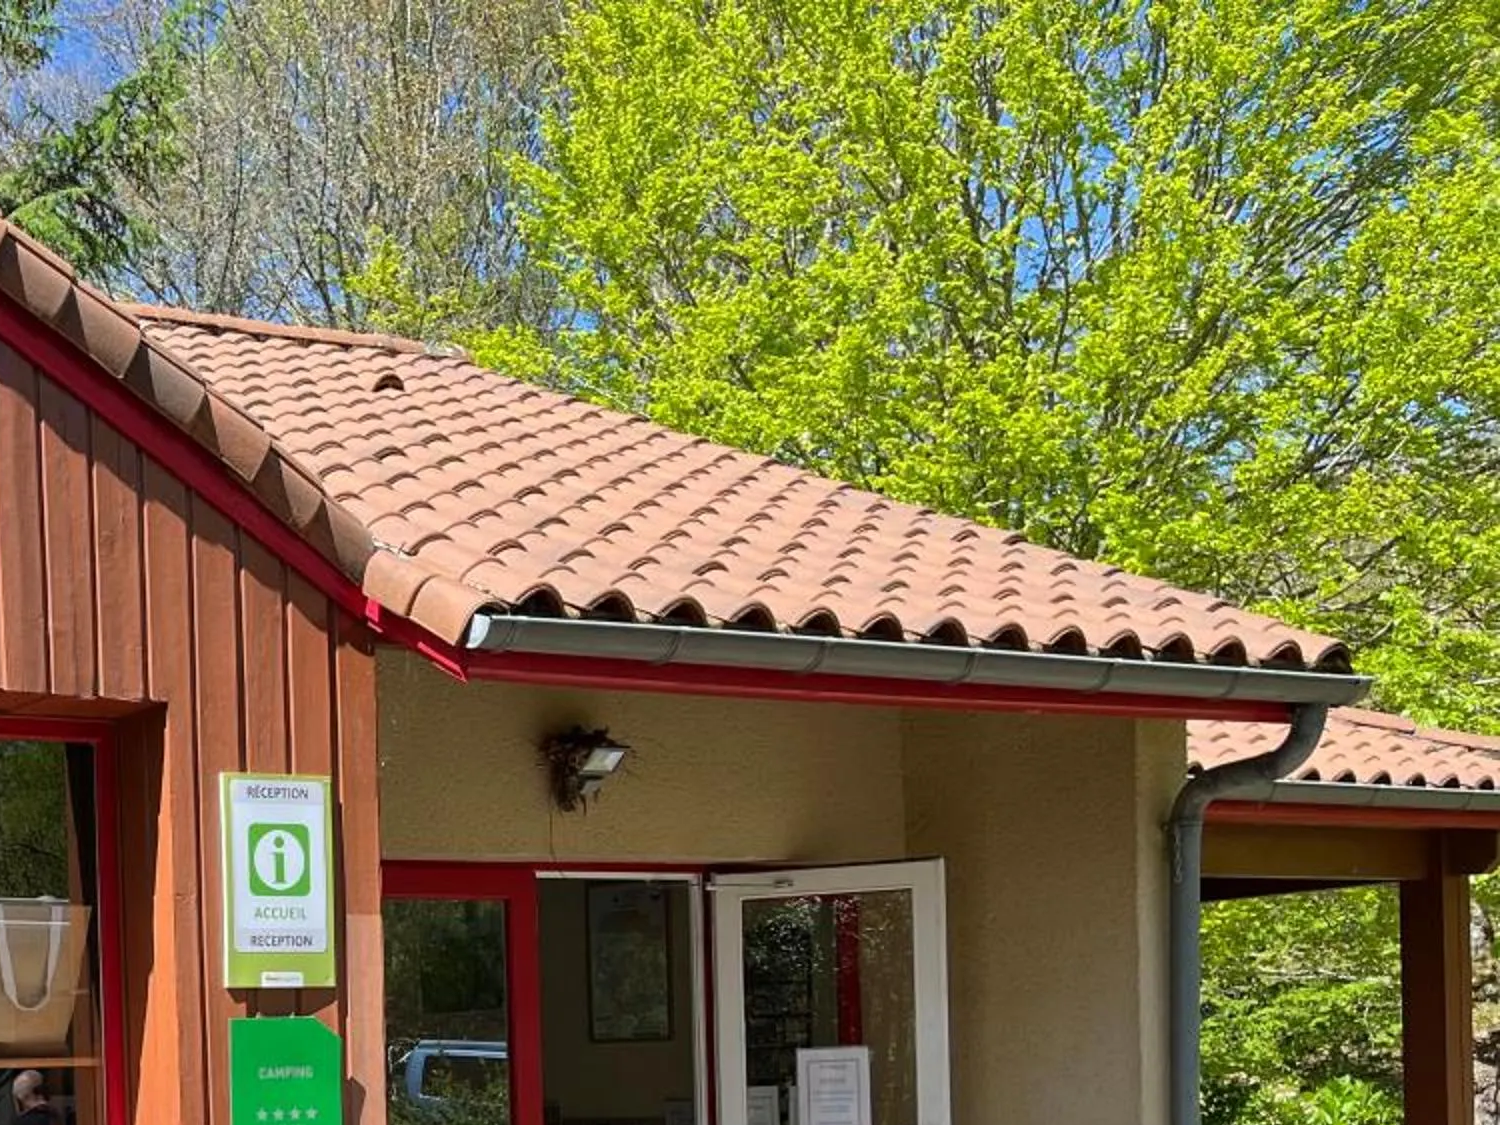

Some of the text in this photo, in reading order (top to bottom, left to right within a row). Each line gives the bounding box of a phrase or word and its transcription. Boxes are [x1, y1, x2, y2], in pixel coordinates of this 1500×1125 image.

[254, 907, 307, 920] ACCUEIL
[250, 935, 313, 948] RECEPTION
[259, 1065, 314, 1080] CAMPING
